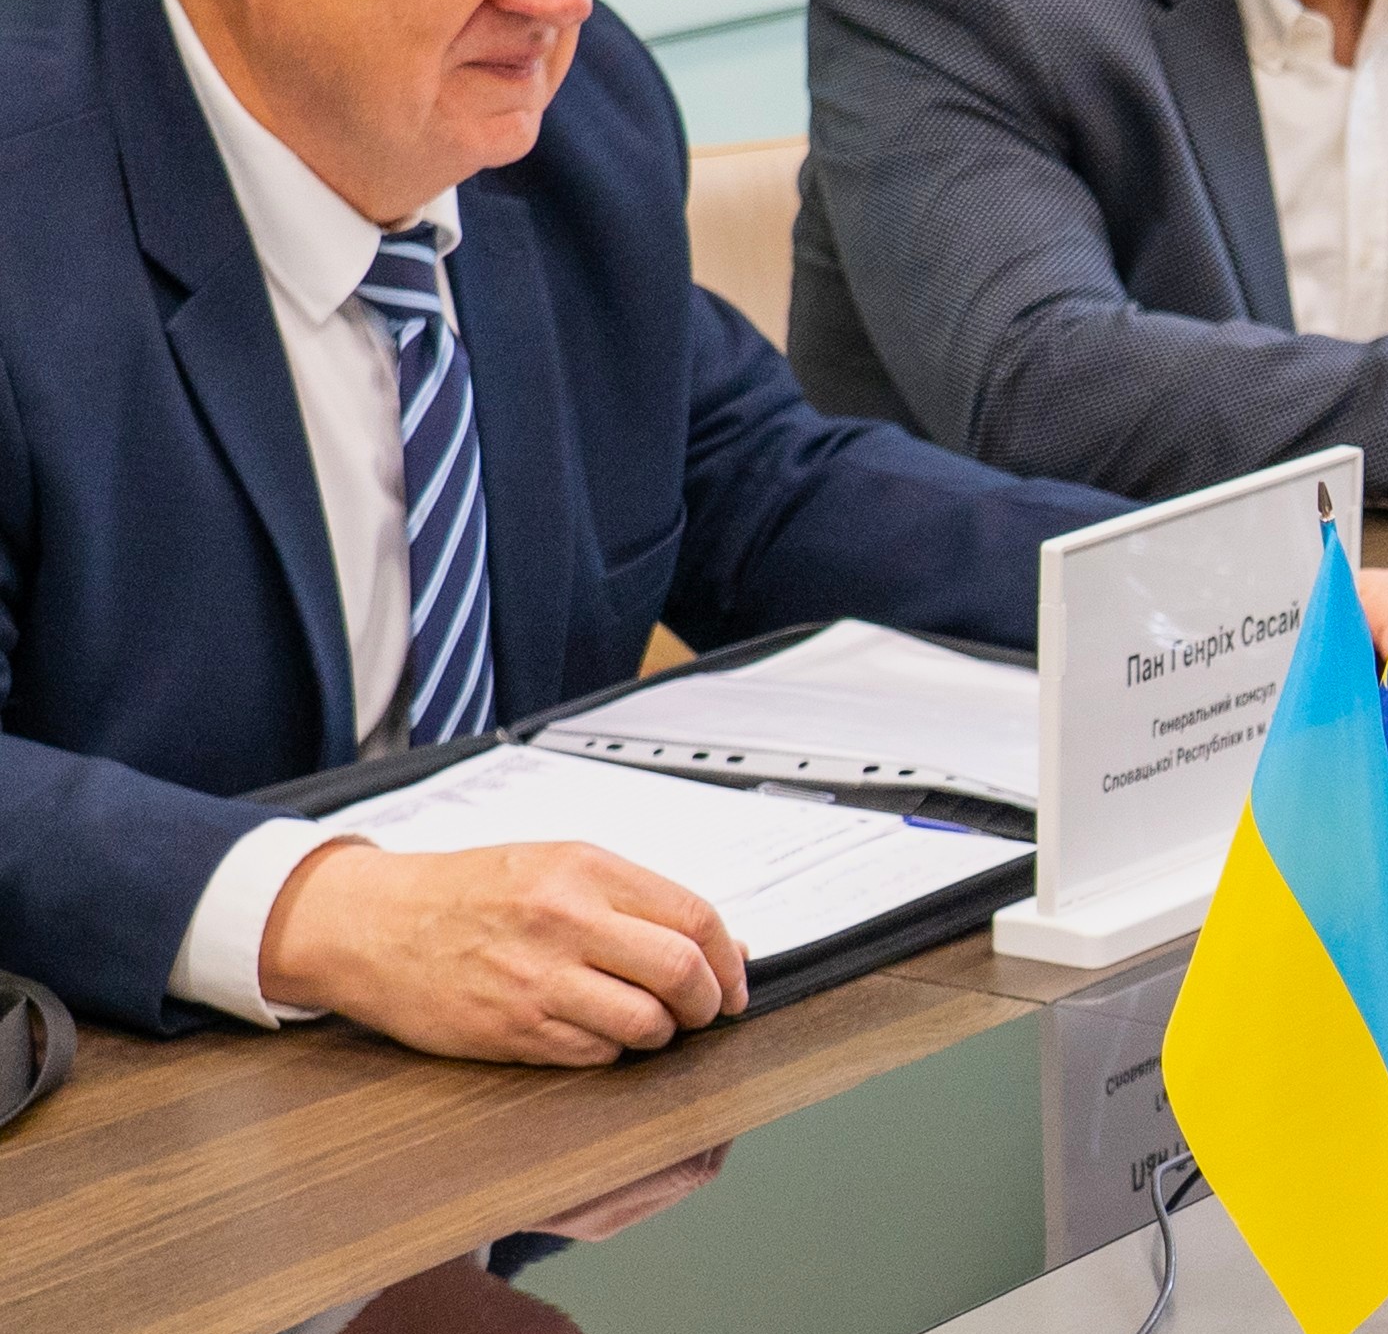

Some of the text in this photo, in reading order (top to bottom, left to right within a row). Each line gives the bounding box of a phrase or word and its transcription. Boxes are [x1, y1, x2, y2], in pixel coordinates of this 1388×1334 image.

[1127, 651, 1165, 688] Пан
[1241, 601, 1300, 646] Сасай
[1152, 682, 1276, 738] Генеральний консул
[1103, 750, 1173, 793] Словацької
[1177, 729, 1243, 766] Республіки
